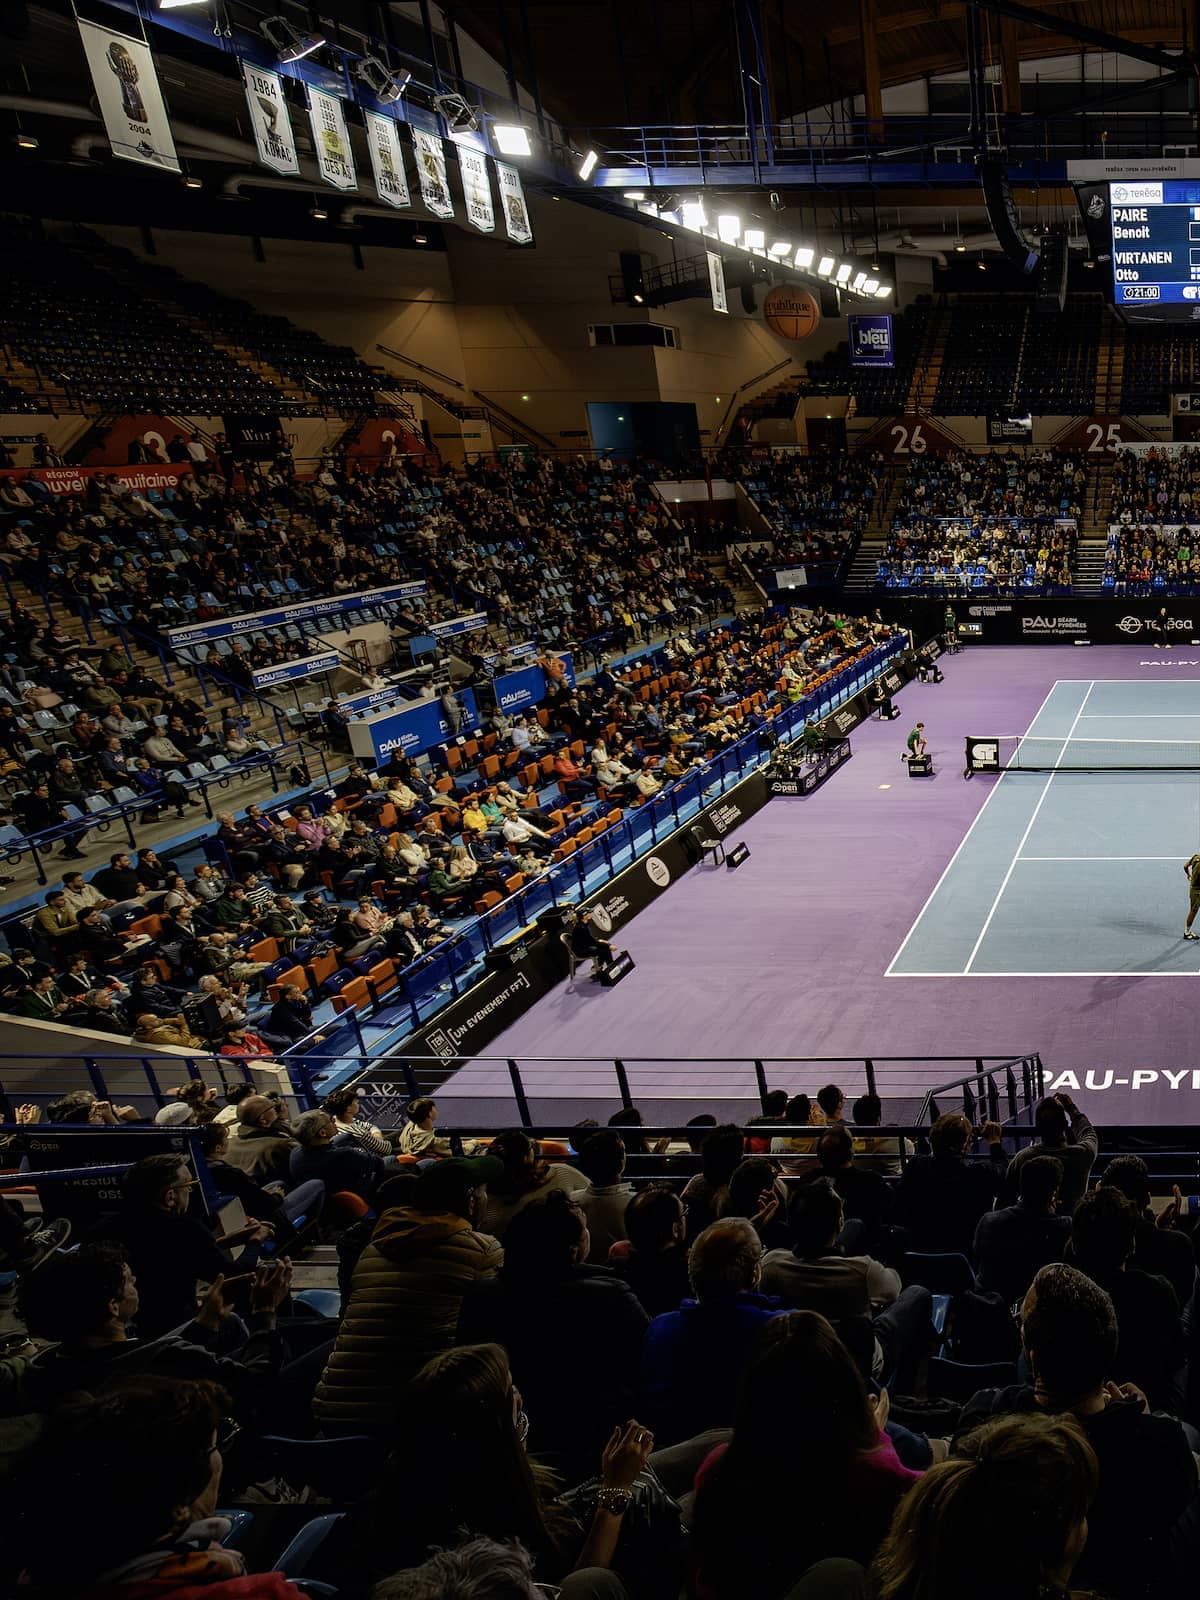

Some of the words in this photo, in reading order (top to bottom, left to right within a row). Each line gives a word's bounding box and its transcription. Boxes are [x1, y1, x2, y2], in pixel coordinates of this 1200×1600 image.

[250, 74, 277, 99] 1984
[128, 122, 152, 136] 2004
[1114, 208, 1148, 222] PAIRE
[1114, 226, 1150, 239] Benoit
[1115, 252, 1172, 264] VIRTANEN
[1116, 270, 1139, 281] Otto
[1134, 288, 1158, 298] 21:00
[859, 330, 888, 345] bleu
[891, 425, 927, 454] 26
[1086, 424, 1122, 452] 25
[1022, 616, 1056, 628] PAU
[379, 737, 401, 754] PAU
[431, 1034, 445, 1048] TEN
[440, 1046, 452, 1058] NIS
